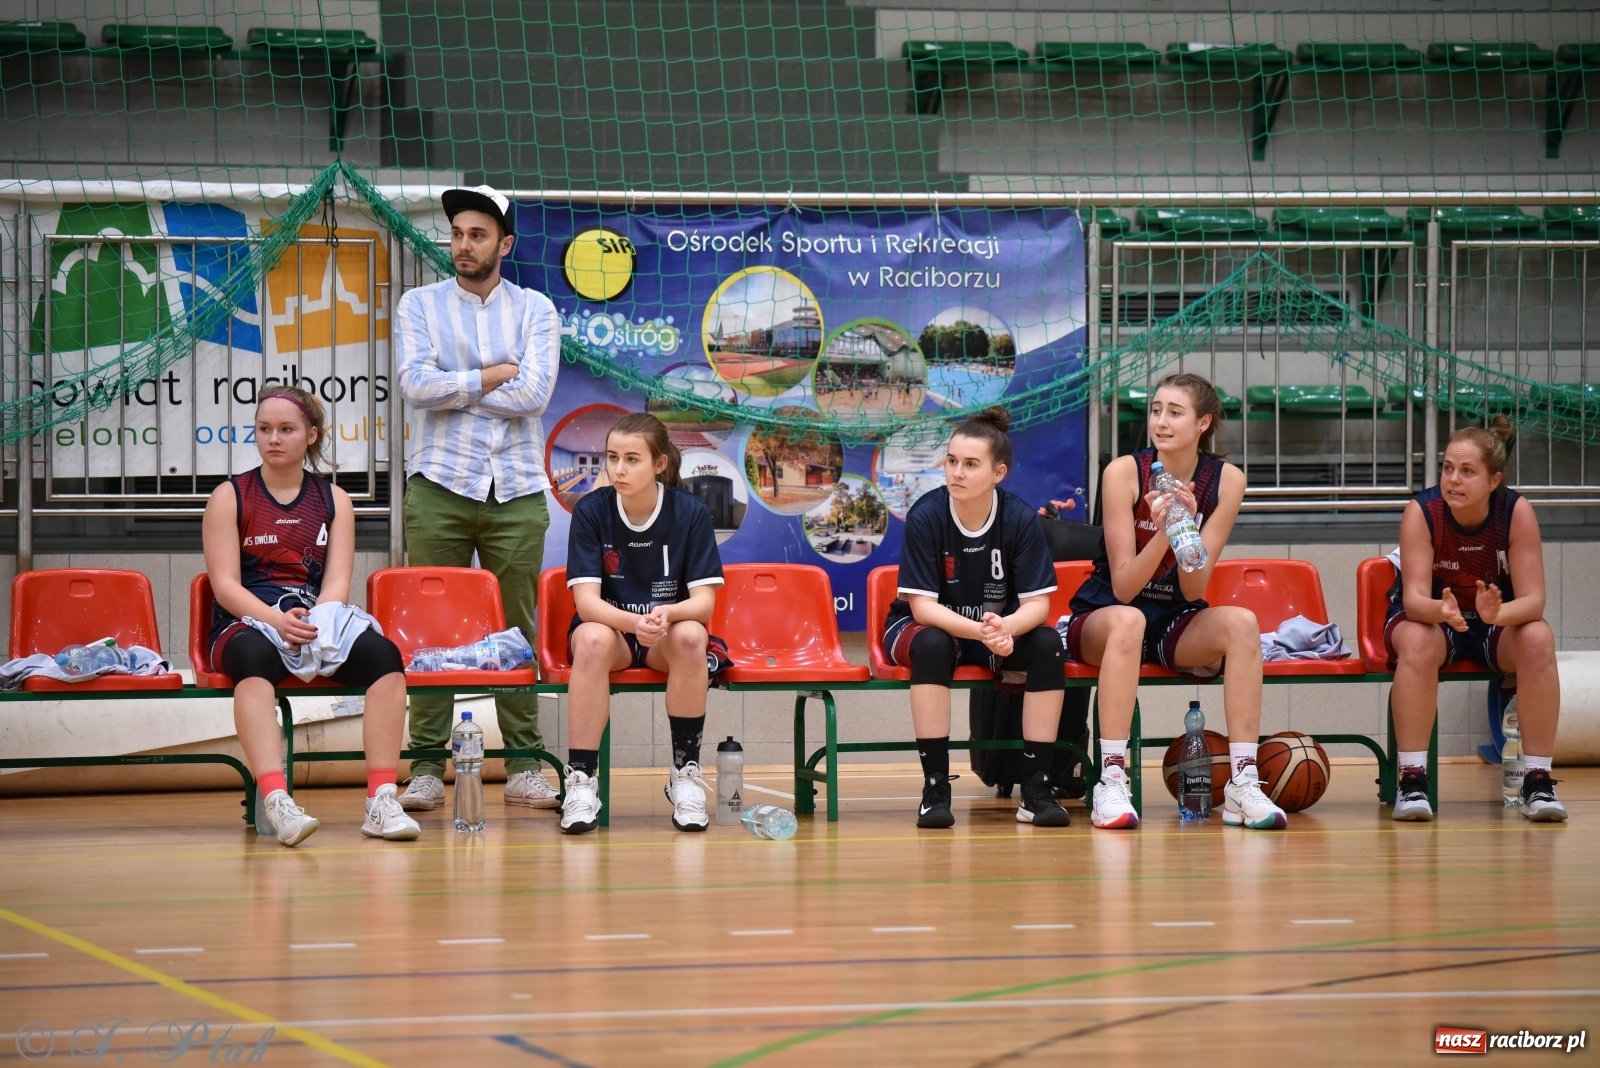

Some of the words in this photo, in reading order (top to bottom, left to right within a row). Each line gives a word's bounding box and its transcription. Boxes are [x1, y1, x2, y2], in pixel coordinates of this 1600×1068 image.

[667, 229, 773, 253] Ośrodek
[781, 231, 862, 258] Sportu
[870, 234, 877, 254] i
[885, 232, 1000, 260] Rekreacji
[847, 271, 870, 287] w
[879, 266, 1001, 288] Raciborzu
[195, 425, 257, 444] oaz
[662, 544, 670, 577] 1
[990, 548, 1005, 580] 8
